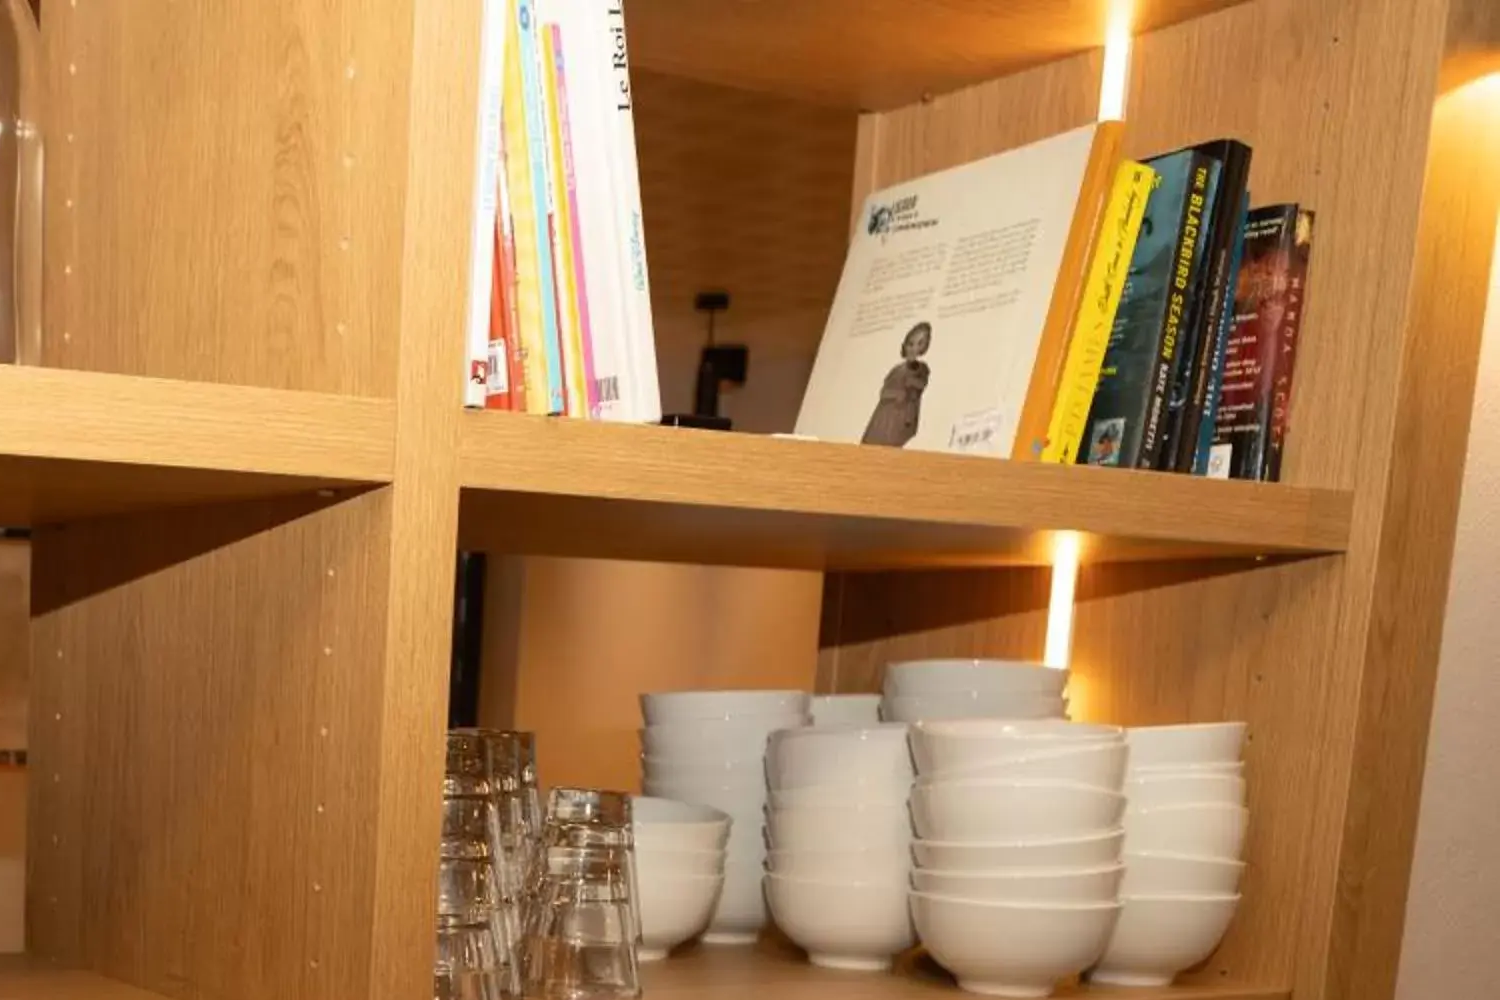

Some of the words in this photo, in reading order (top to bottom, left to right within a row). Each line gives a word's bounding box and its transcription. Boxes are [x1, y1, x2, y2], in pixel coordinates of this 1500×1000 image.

[609, 27, 626, 70] Roi
[1195, 167, 1207, 190] THE
[1176, 194, 1203, 289] BLACKBIRD
[1161, 291, 1183, 359] SEASON
[1155, 362, 1170, 395] KATE
